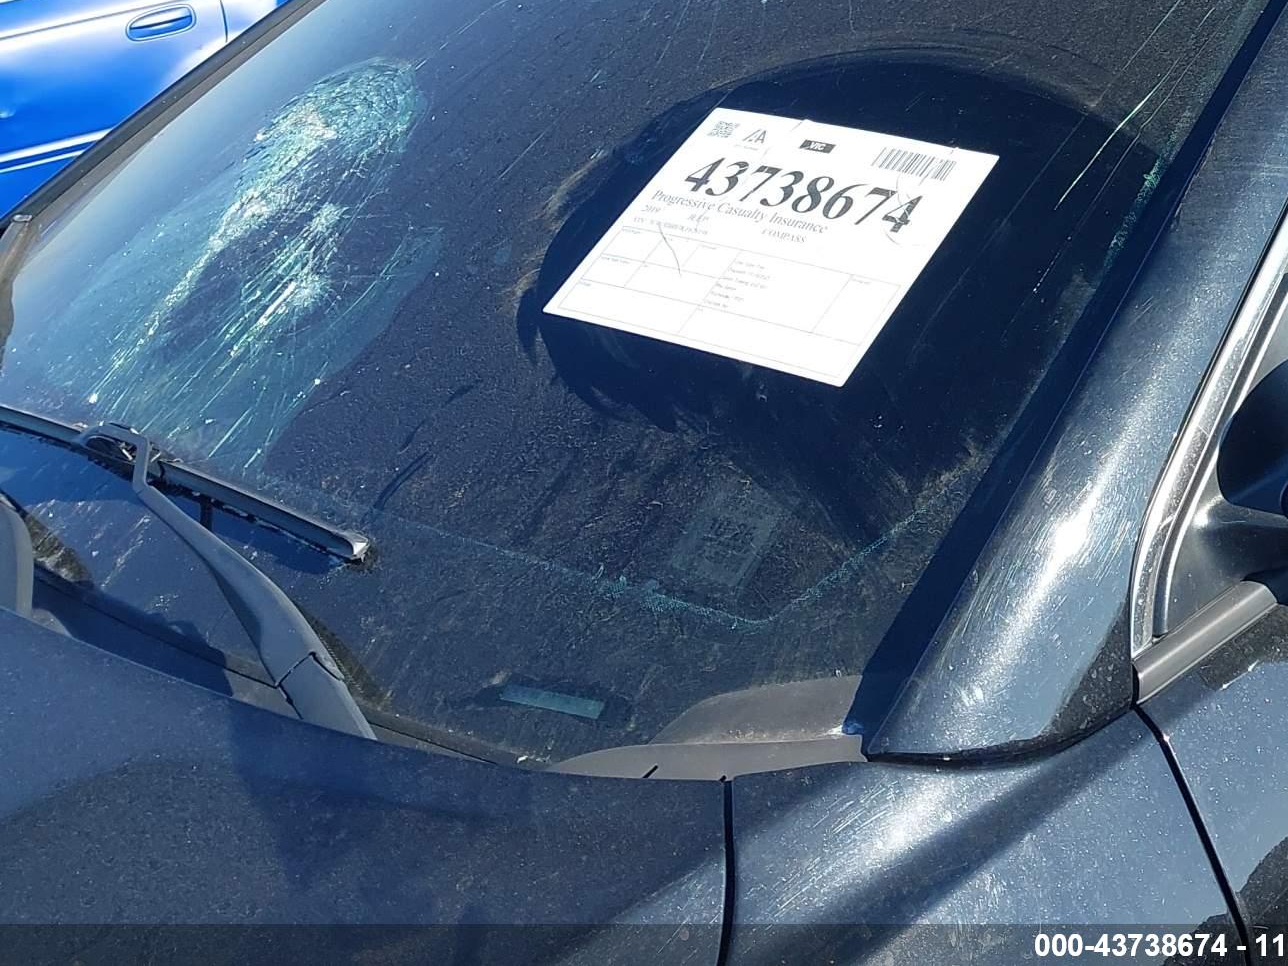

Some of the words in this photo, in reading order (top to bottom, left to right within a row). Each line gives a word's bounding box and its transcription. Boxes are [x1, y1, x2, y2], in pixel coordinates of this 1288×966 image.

[652, 189, 717, 212] Progressive
[717, 201, 769, 223] Casualty
[768, 211, 829, 235] Insurance
[684, 156, 923, 234] 43738674
